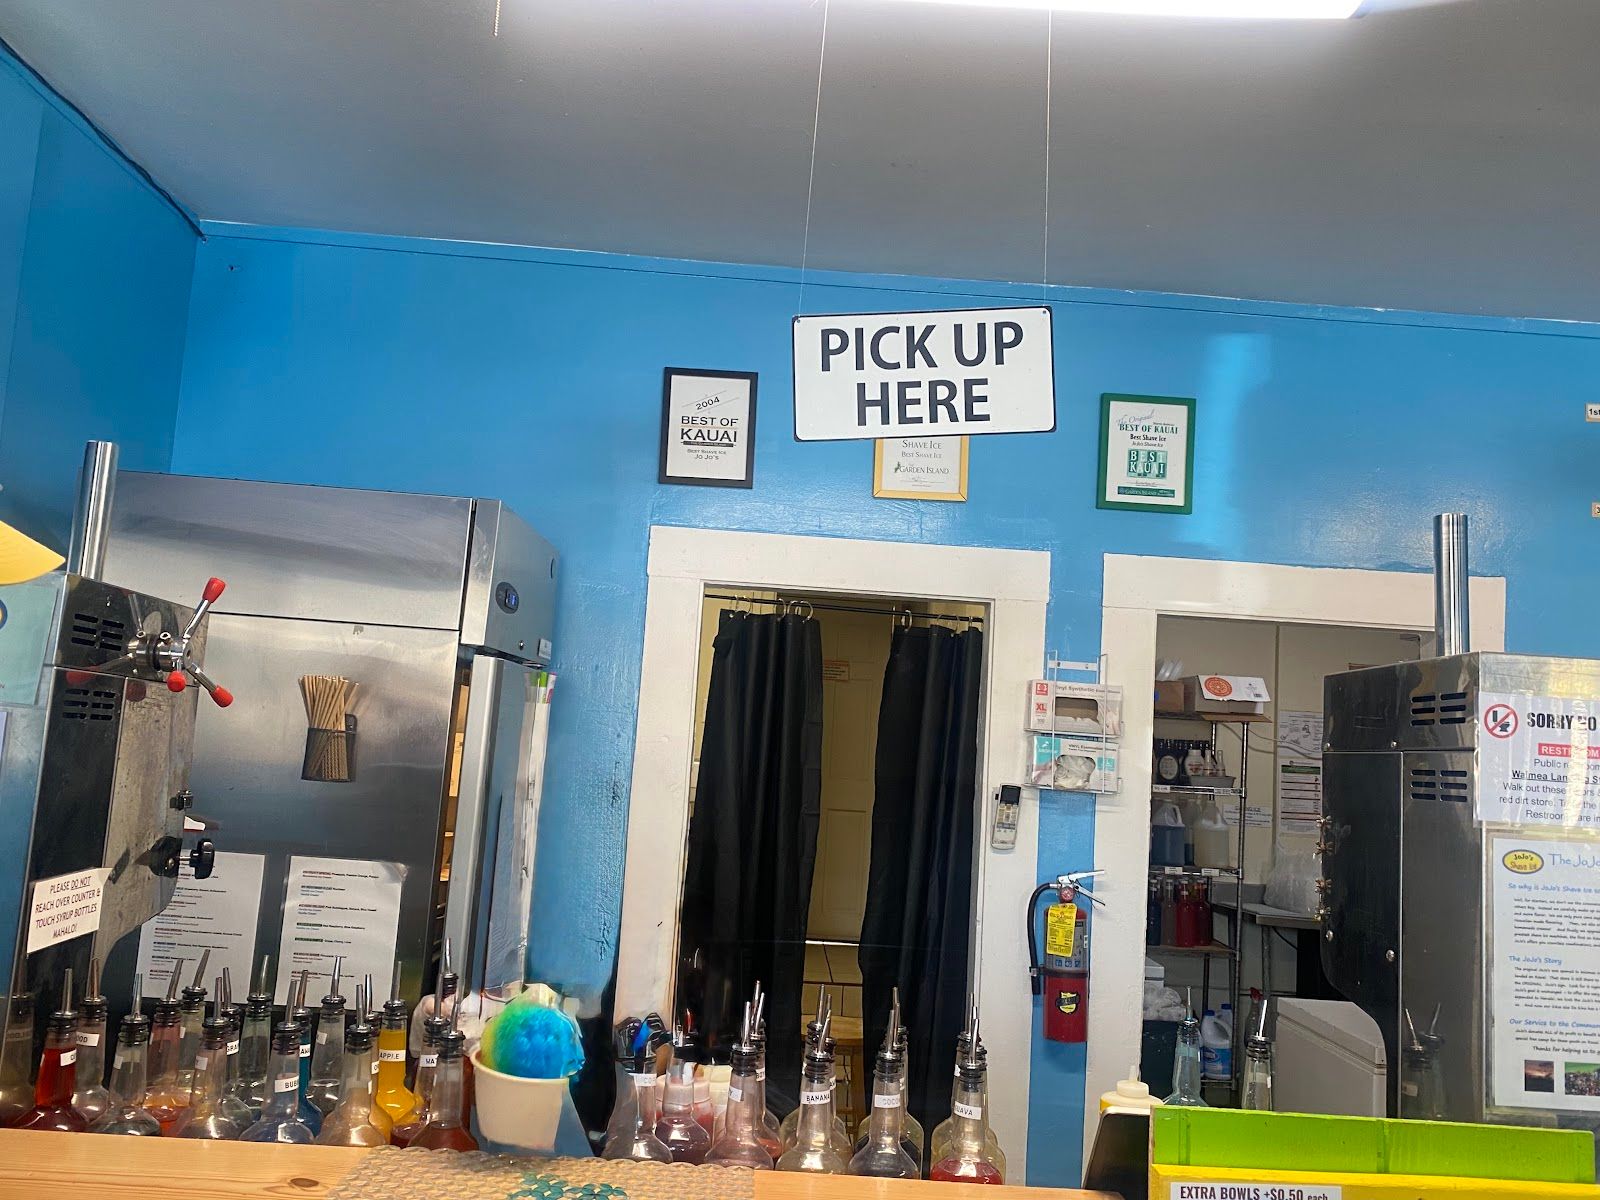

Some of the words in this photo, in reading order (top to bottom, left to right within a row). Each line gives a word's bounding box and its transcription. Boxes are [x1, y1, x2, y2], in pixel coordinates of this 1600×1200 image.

[820, 325, 938, 372] PICK
[953, 321, 1024, 367] UP
[696, 396, 720, 410] 2004
[857, 378, 991, 426] HERE
[681, 415, 716, 426] BEST
[720, 417, 739, 427] OF
[1119, 423, 1140, 432] BEST
[1142, 425, 1152, 433] OF
[1154, 426, 1178, 434] KAUAI
[680, 428, 737, 442] KAUAI
[902, 439, 928, 449] SHAVE
[930, 440, 942, 449] ICE
[901, 450, 914, 458] BEST
[1130, 450, 1165, 462] BEST
[899, 465, 925, 473] GARDEN
[926, 466, 949, 474] ISLAND
[1130, 461, 1164, 474] KAUAI
[1036, 703, 1047, 711] XL
[1527, 711, 1574, 730] SORRY
[1534, 759, 1561, 769] Public
[1512, 770, 1548, 780] Waimea
[1503, 782, 1523, 791] Walk
[1526, 784, 1540, 792] out
[1542, 785, 1566, 794] these
[1499, 796, 1513, 804] red
[1515, 796, 1528, 804] dirt
[1583, 801, 1597, 809] the
[1577, 814, 1591, 822] are
[1548, 853, 1571, 866] The
[49, 881, 70, 894] PLEASE
[70, 880, 79, 889] DO
[80, 876, 92, 886] NOT
[35, 900, 55, 914] REACH
[55, 896, 70, 908] OVER
[71, 890, 96, 904] COUNTER
[36, 915, 55, 929] TOUCH
[56, 910, 73, 923] SYRUP
[74, 903, 97, 917] BOTTLES
[52, 923, 78, 938] MAHALO!
[1544, 957, 1562, 965] Story
[1524, 1018, 1547, 1026] Service
[1180, 1186, 1216, 1200] EXTRA
[1220, 1187, 1260, 1200] BOWLS
[1263, 1188, 1304, 1200] +$0.50
[1307, 1192, 1328, 1200] each
